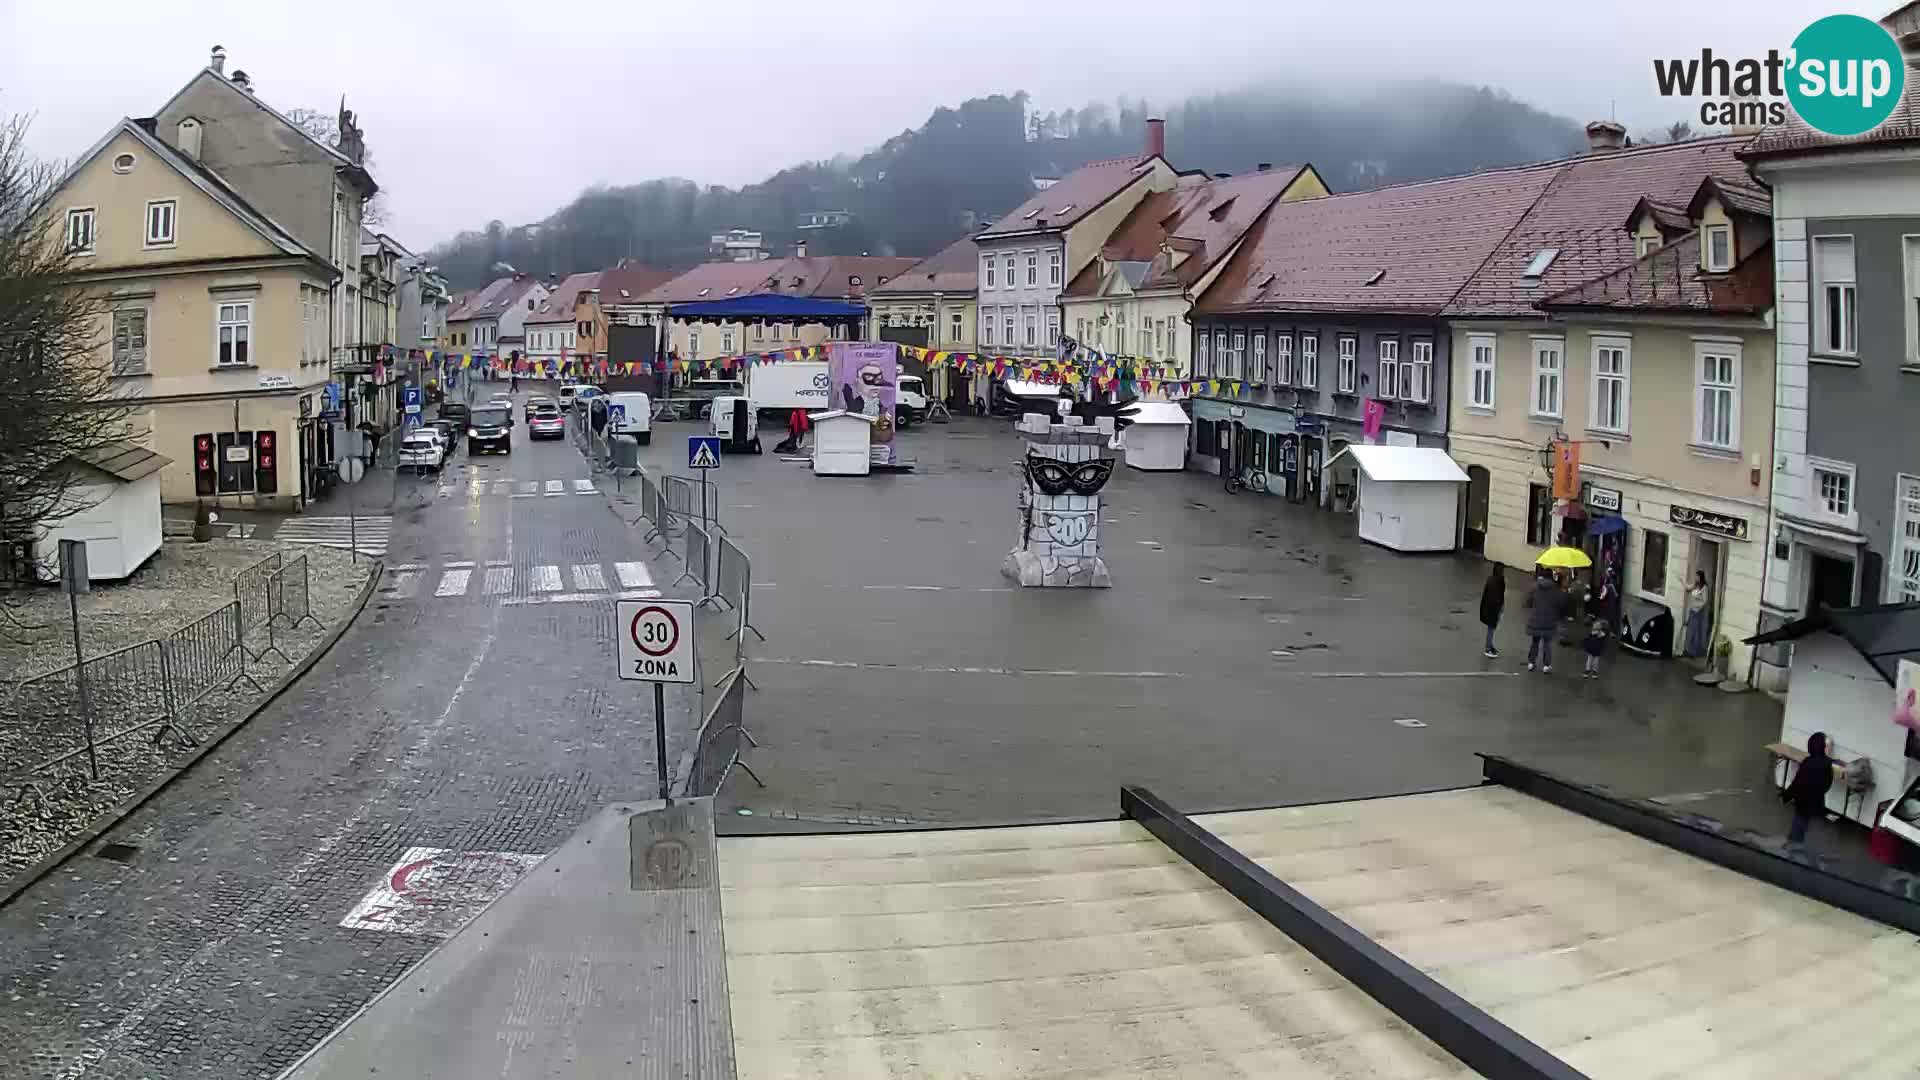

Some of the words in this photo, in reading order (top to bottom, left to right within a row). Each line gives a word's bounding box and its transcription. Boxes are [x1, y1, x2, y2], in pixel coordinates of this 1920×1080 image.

[408, 391, 417, 401] P
[1048, 516, 1087, 544] 200
[643, 622, 668, 643] 30
[634, 659, 678, 676] ZONA
